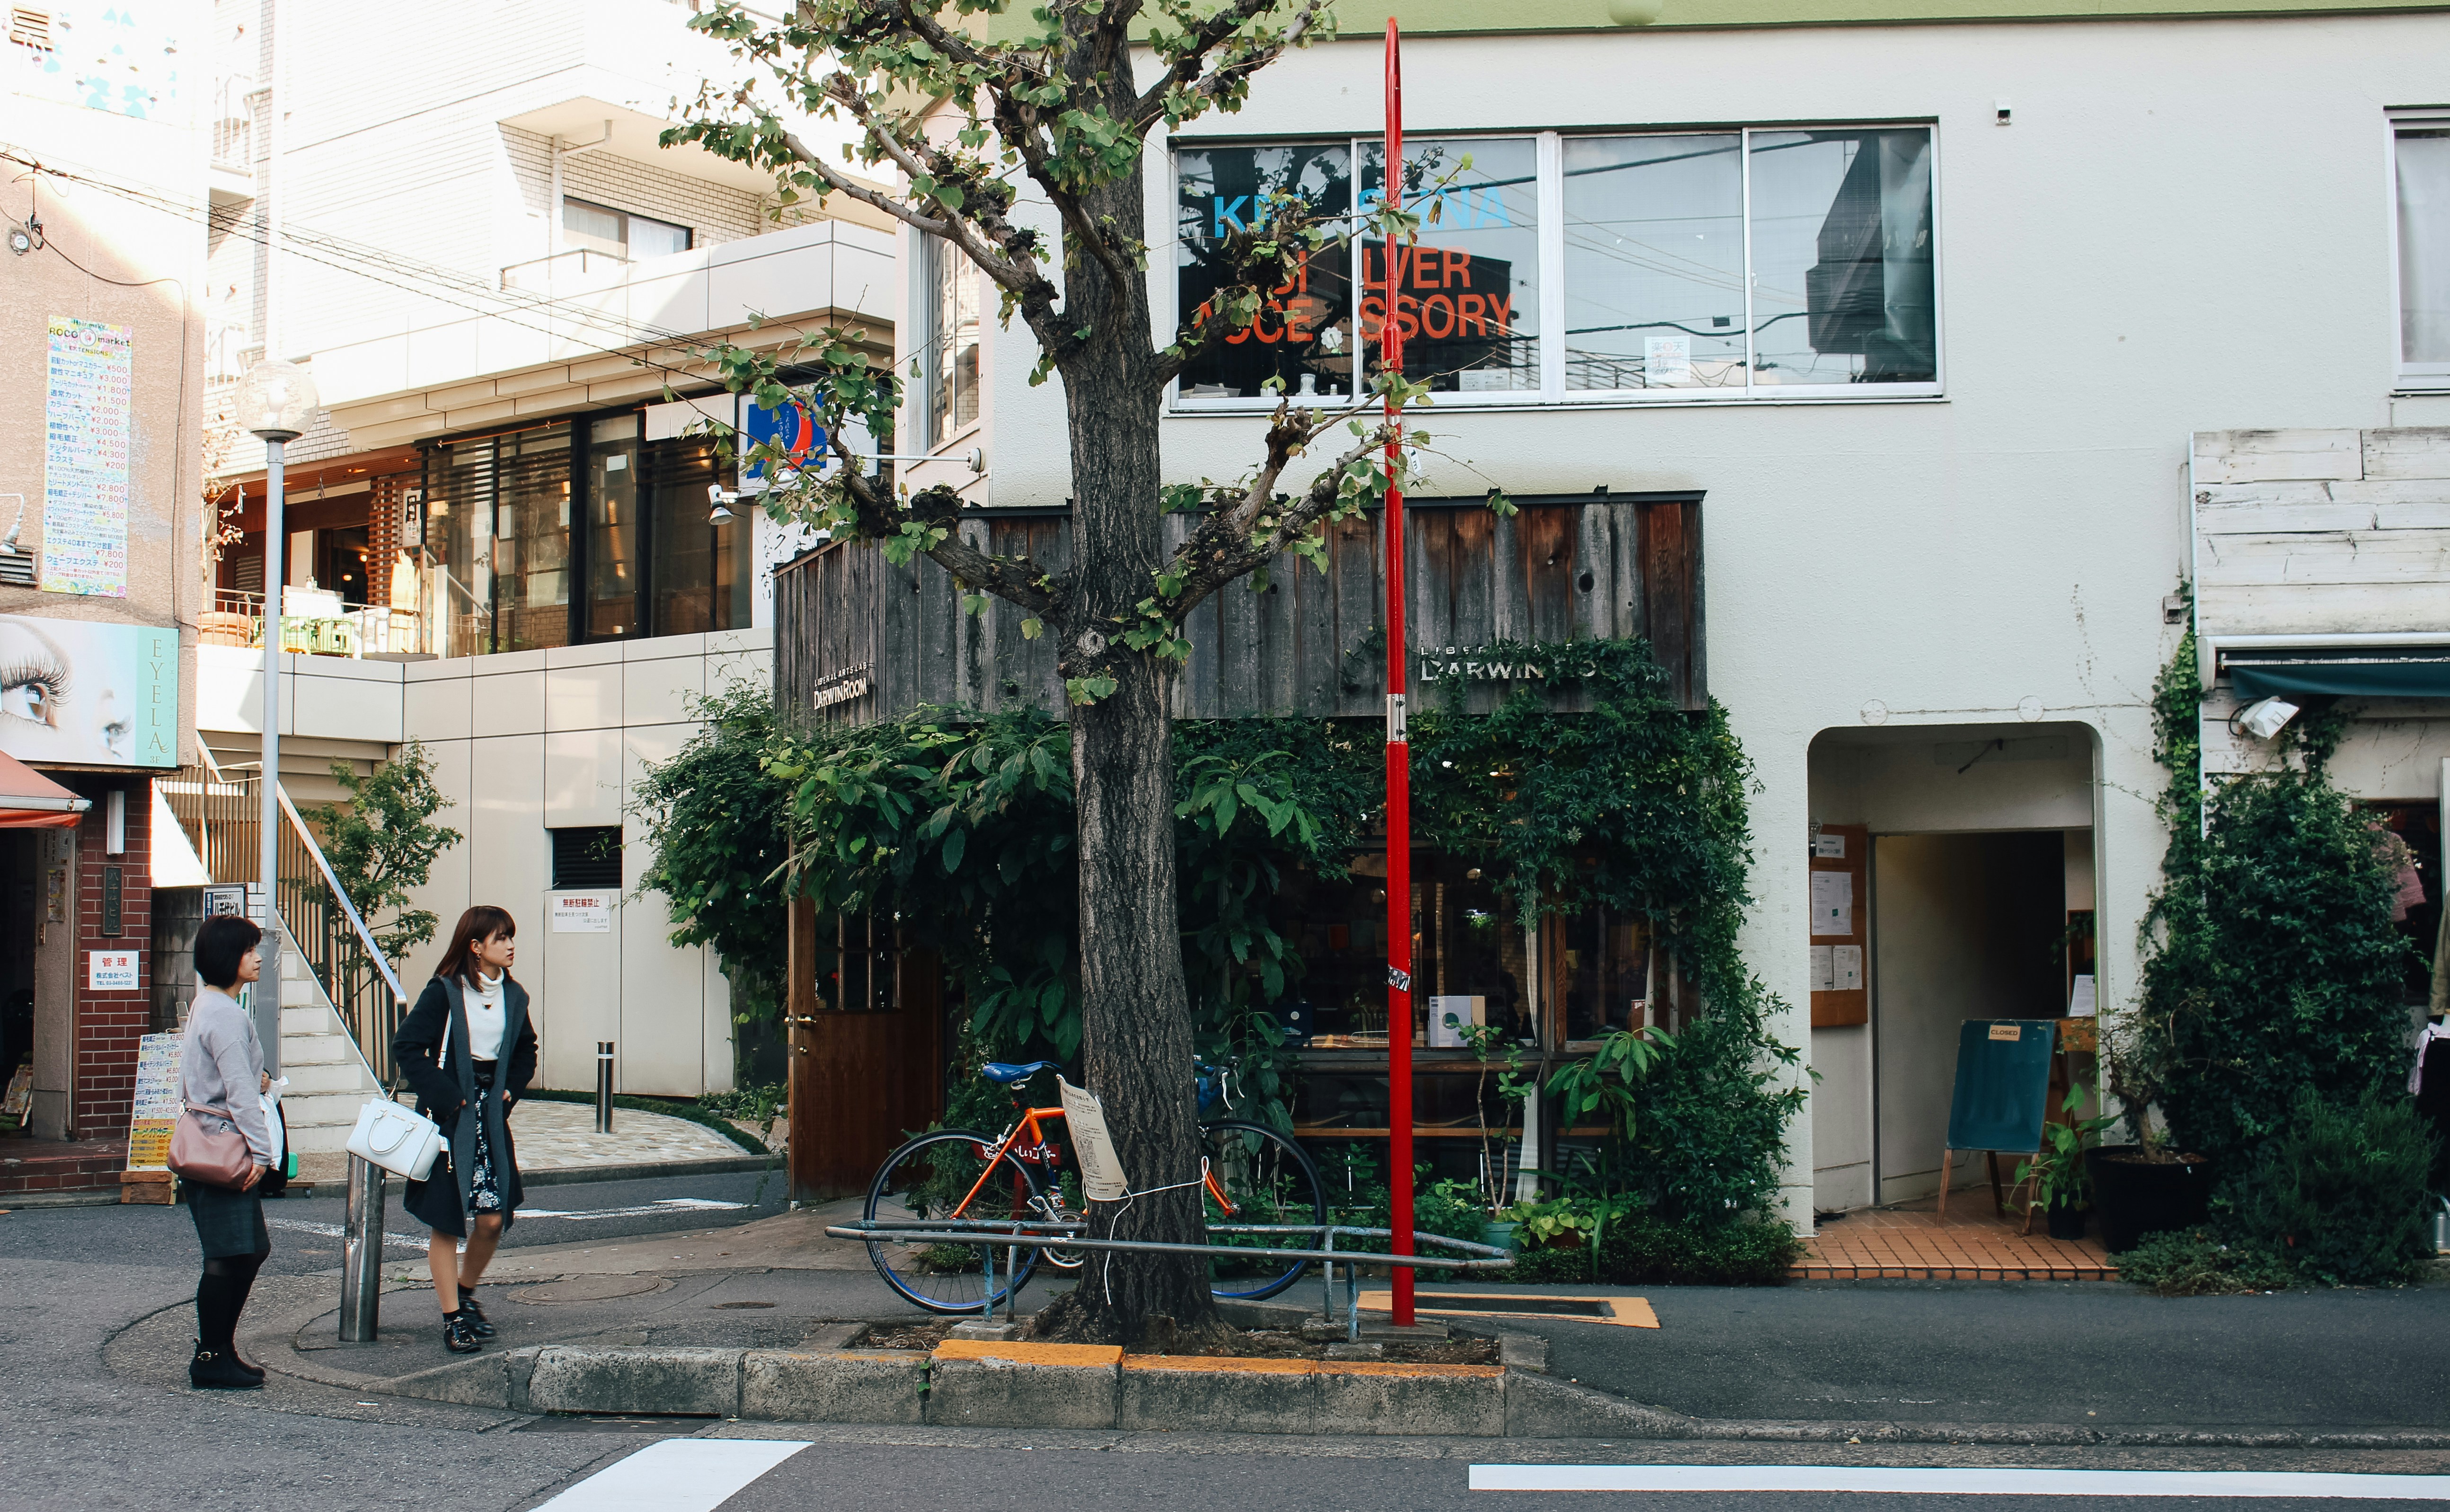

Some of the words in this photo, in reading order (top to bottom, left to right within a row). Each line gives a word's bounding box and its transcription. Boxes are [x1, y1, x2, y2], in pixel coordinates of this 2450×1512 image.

[49, 327, 78, 338] ROCO
[98, 337, 130, 346] market
[69, 345, 108, 356] EXTENSIONS
[106, 364, 127, 373] ¥500
[51, 368, 94, 379] 酸性マニキュア
[99, 374, 127, 384] ¥3,000
[97, 385, 127, 395] ¥1,800
[51, 389, 83, 399] 通常カット
[97, 396, 126, 406] ¥1,500
[50, 422, 81, 432] 植物性ヘナ
[97, 438, 125, 448] ¥4,500
[97, 449, 125, 459] ¥4,300
[49, 455, 74, 464] エクステ
[106, 461, 125, 470] ¥200
[49, 478, 80, 488] トリートメント
[97, 484, 124, 493] ¥2,800
[96, 494, 124, 503] ¥7,800
[103, 511, 124, 519] ¥5,800
[96, 549, 123, 558] ¥7,800
[104, 560, 123, 568] ¥200
[814, 672, 837, 687] LIBERAL
[838, 666, 853, 678] ARTS
[855, 661, 867, 672] LAB
[148, 639, 170, 753] EYELA
[103, 957, 127, 967] 管理
